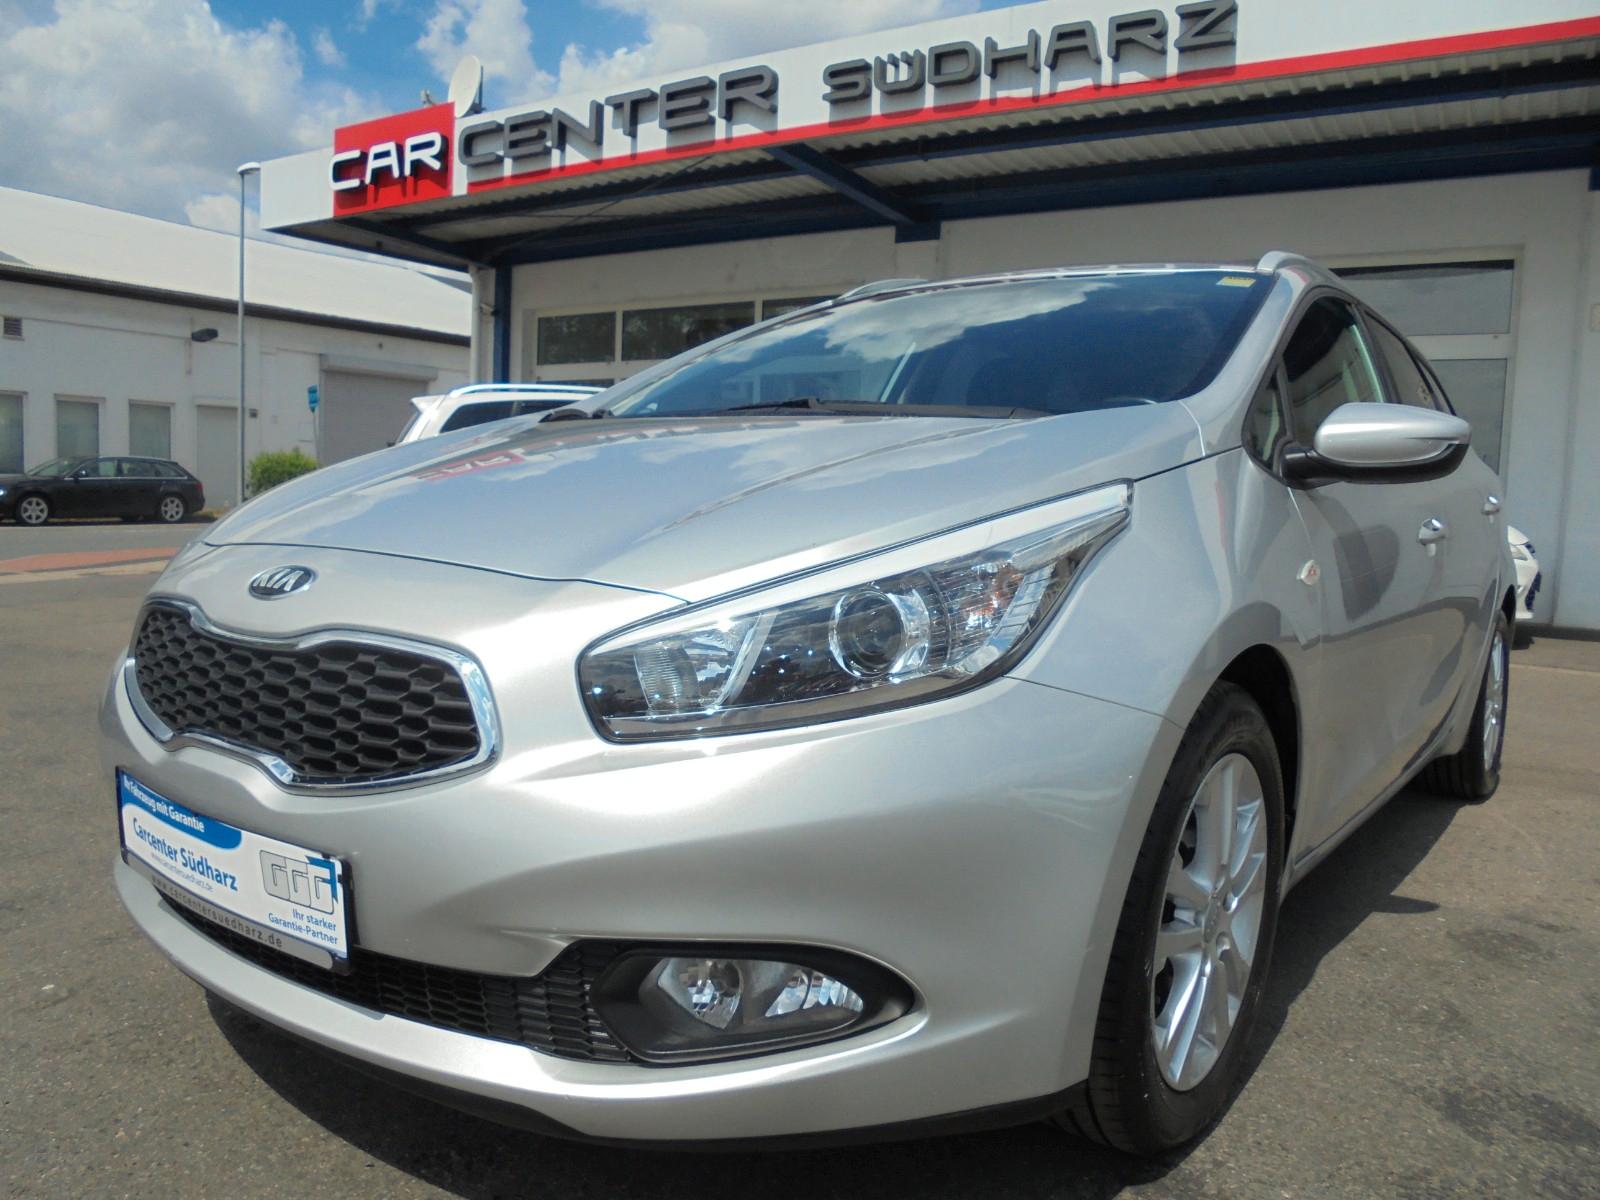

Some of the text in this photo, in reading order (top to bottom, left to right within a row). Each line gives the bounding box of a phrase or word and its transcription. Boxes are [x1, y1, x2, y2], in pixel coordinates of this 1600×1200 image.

[329, 0, 1238, 191] CAR CENTER SÜDHARZ
[253, 568, 304, 592] KIA
[156, 801, 168, 816] mit
[168, 805, 205, 833] Garantie
[133, 817, 178, 862] Carcenter
[180, 847, 238, 891] Südharz
[268, 912, 338, 945] Garantie-Partner
[293, 907, 337, 931] Ihr starker
